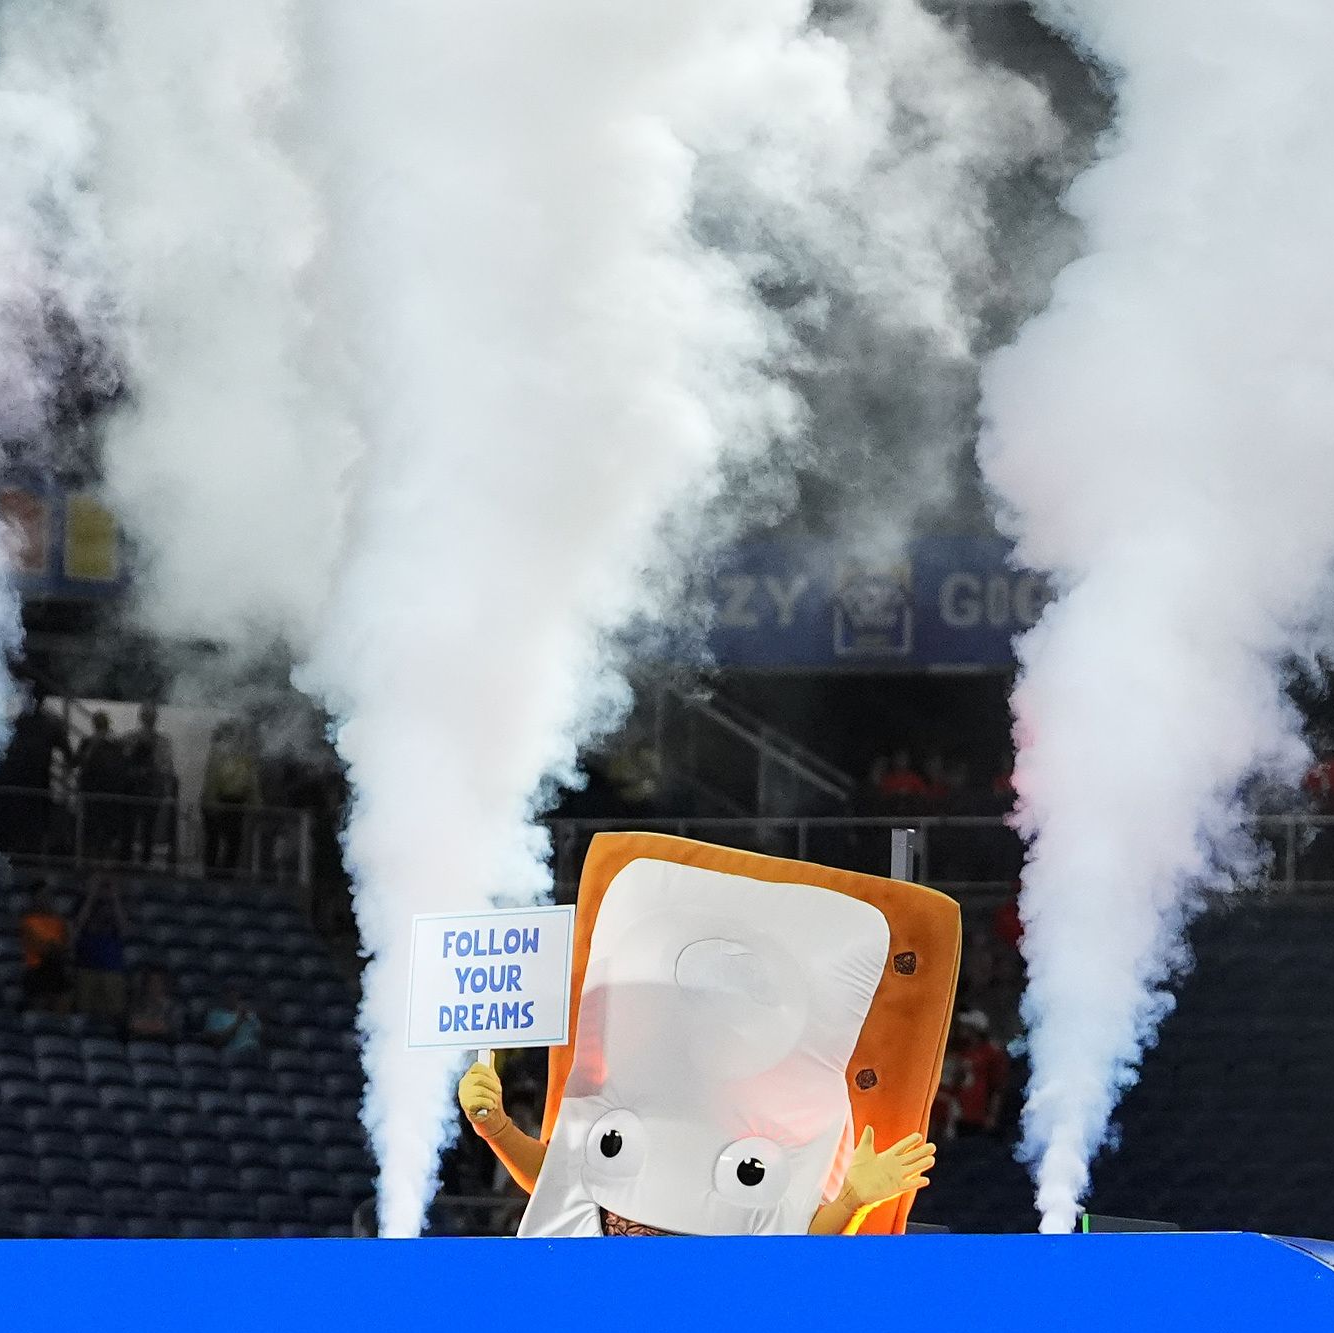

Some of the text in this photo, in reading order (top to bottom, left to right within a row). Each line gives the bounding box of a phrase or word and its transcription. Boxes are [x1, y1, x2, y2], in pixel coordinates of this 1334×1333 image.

[442, 927, 540, 958] FOLLOW
[455, 964, 522, 994] YOUR
[439, 1001, 535, 1032] DREAMS
